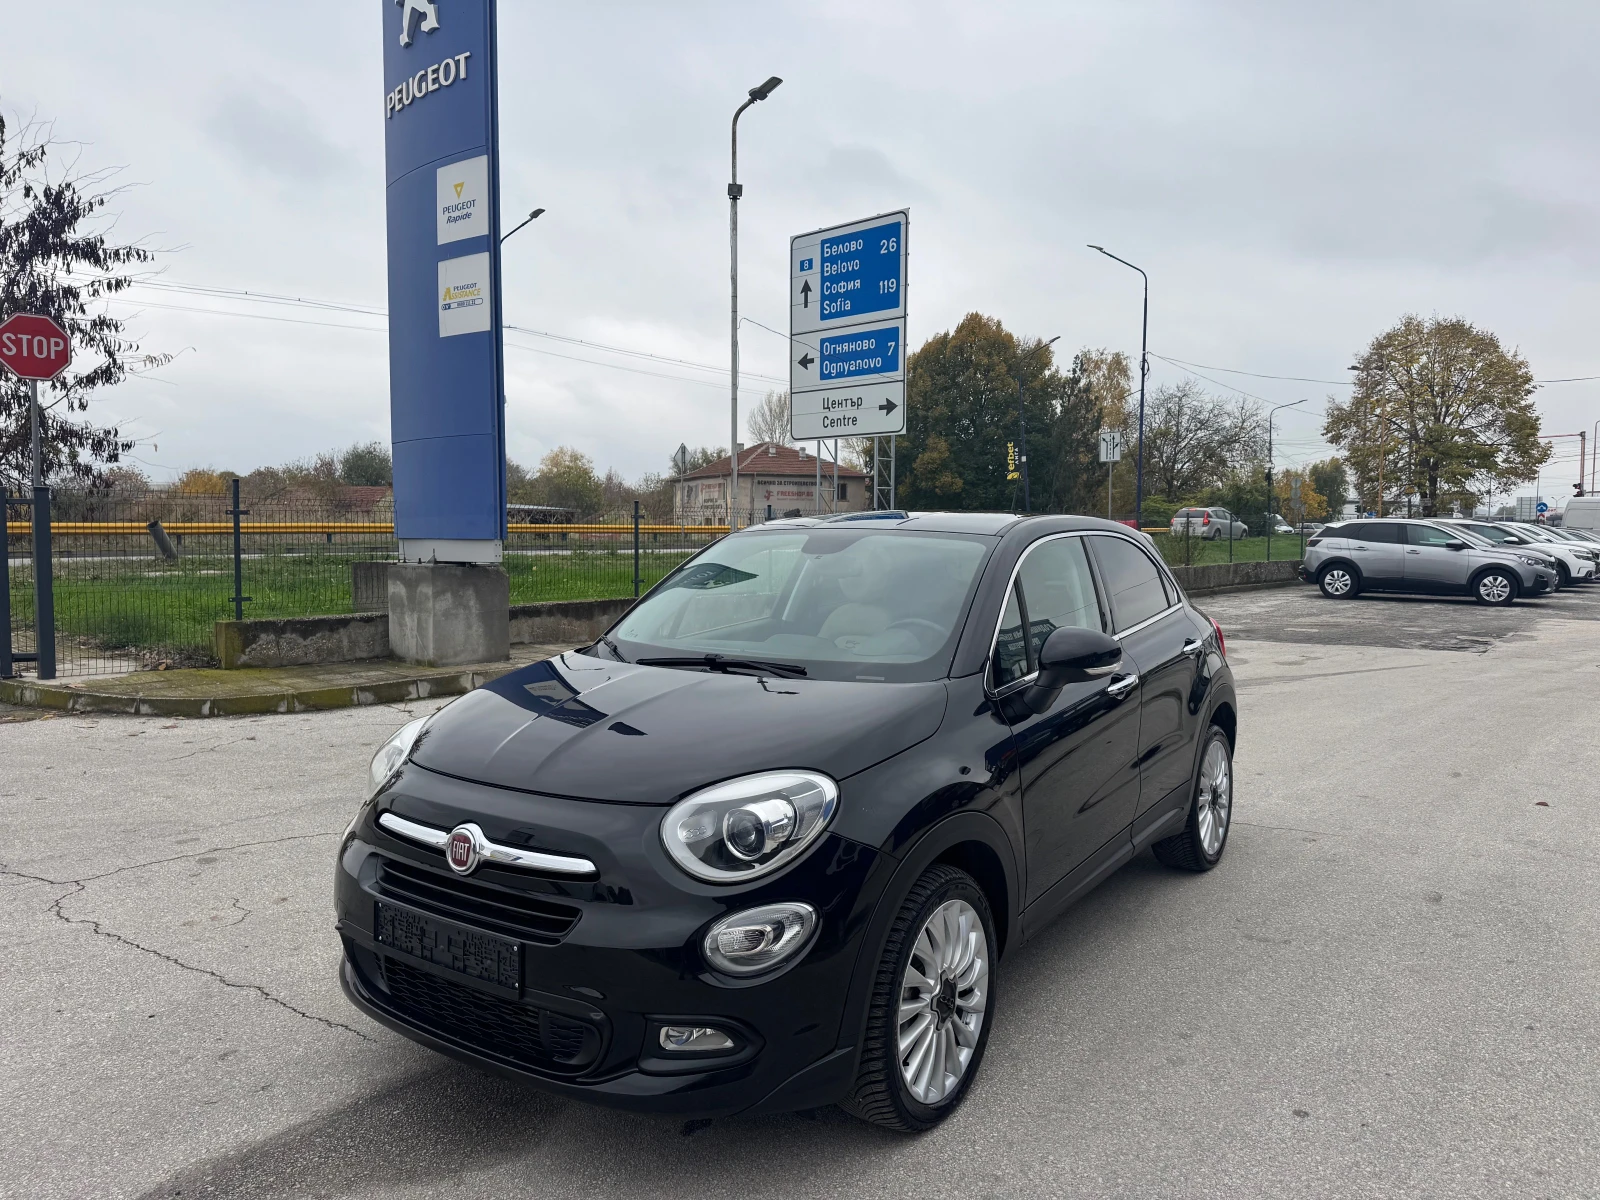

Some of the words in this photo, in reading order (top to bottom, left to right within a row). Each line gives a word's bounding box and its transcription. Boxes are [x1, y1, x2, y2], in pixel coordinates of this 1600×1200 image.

[386, 51, 472, 119] PEUGEOT
[442, 199, 476, 215] PEUGEOT
[446, 211, 472, 224] Rapide
[823, 239, 863, 257] Белово
[880, 238, 897, 254] 26
[803, 260, 809, 270] 8
[823, 259, 860, 276] Belovo
[453, 282, 477, 292] PEUGEOT
[823, 279, 861, 295] София
[879, 278, 897, 294] 119
[823, 298, 851, 314] Sofia
[2, 332, 64, 360] STOP
[823, 339, 876, 355] Огняново
[887, 341, 896, 356] 7
[823, 357, 882, 376] Ognyanovo
[822, 397, 863, 412] Център
[822, 414, 858, 429] Centre
[452, 841, 470, 861] FIAT
